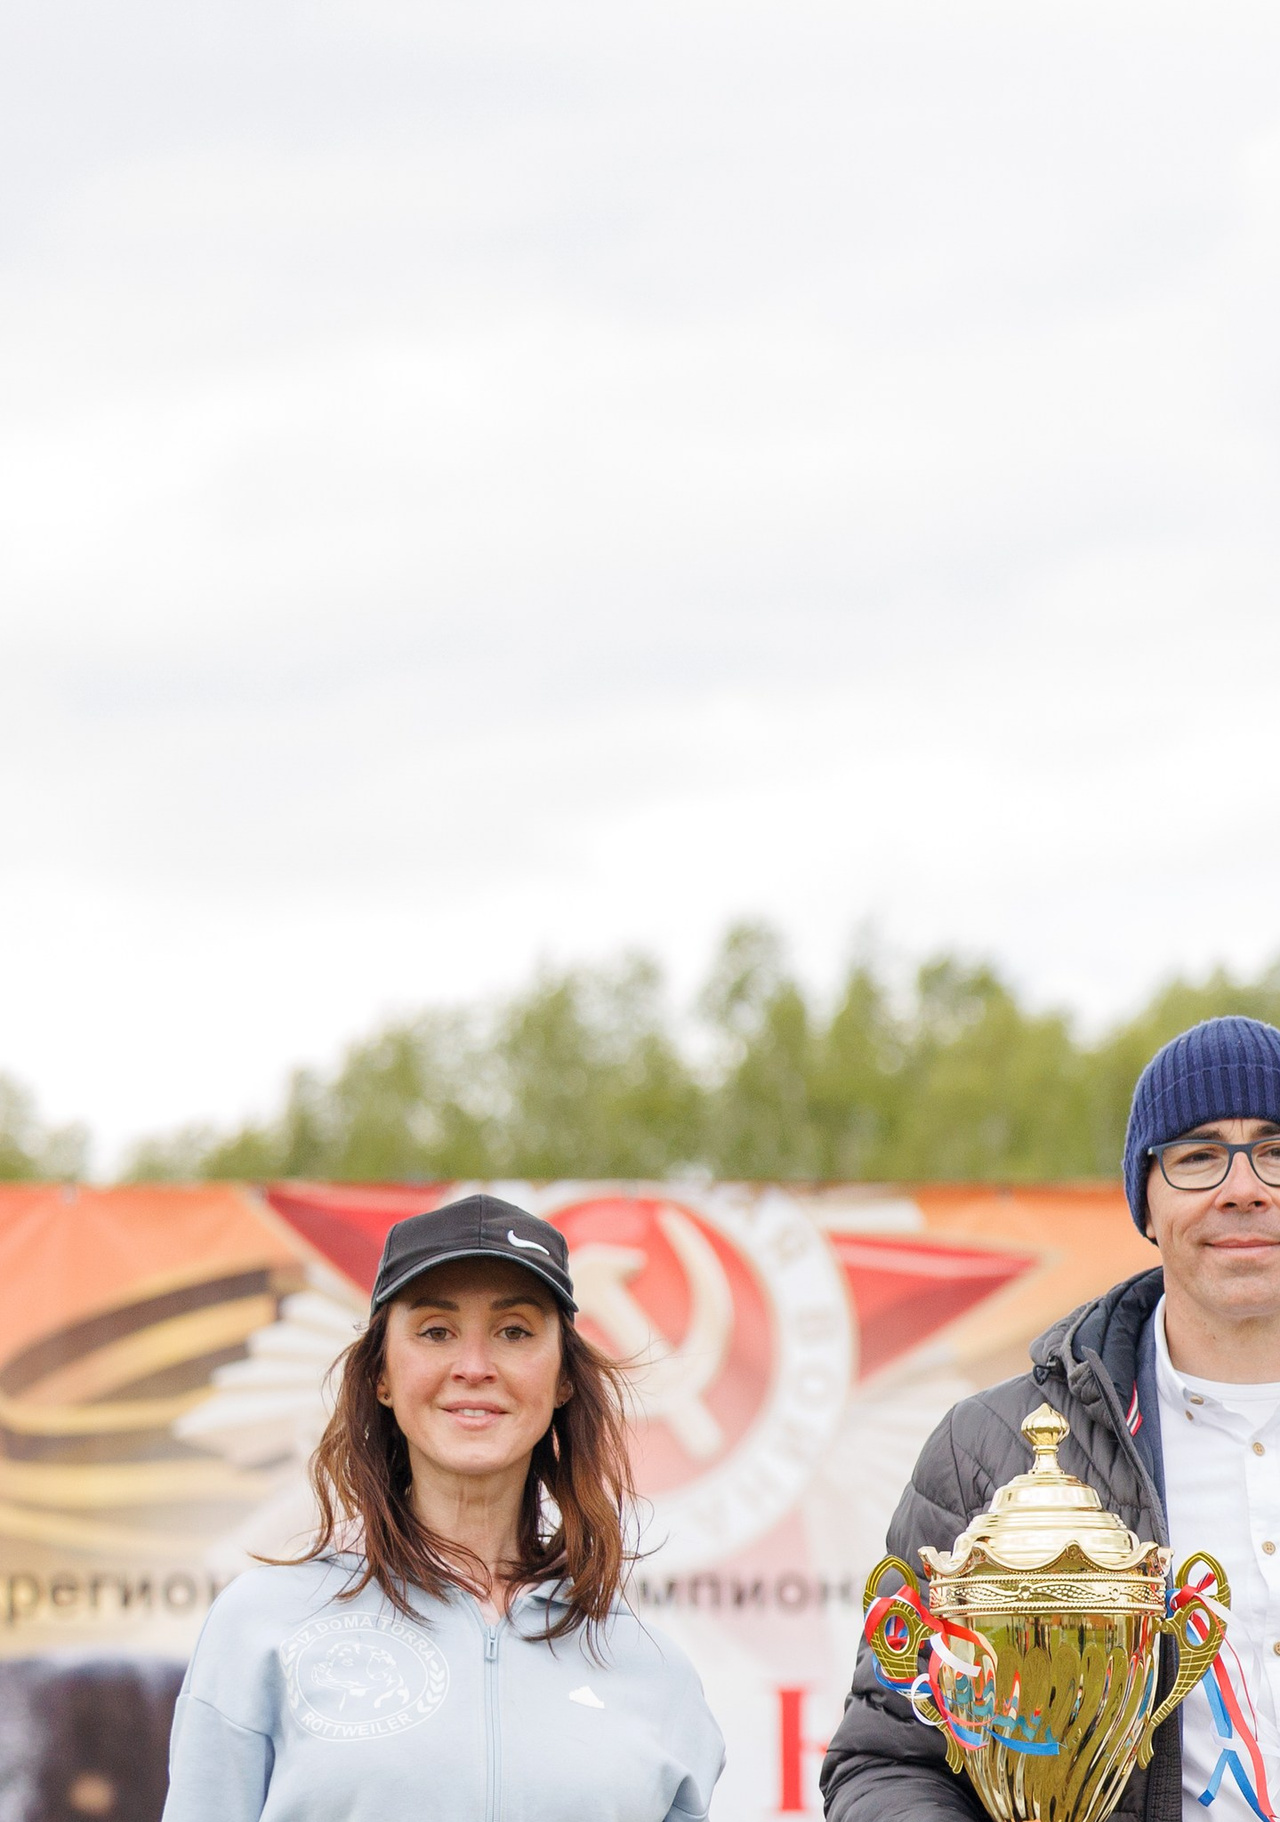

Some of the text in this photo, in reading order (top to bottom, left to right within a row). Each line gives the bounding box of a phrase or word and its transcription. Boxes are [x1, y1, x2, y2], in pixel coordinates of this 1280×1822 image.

[315, 1614, 374, 1635] DOMA
[379, 1617, 438, 1662] TORRA
[301, 1710, 413, 1738] ROTTWEILER
